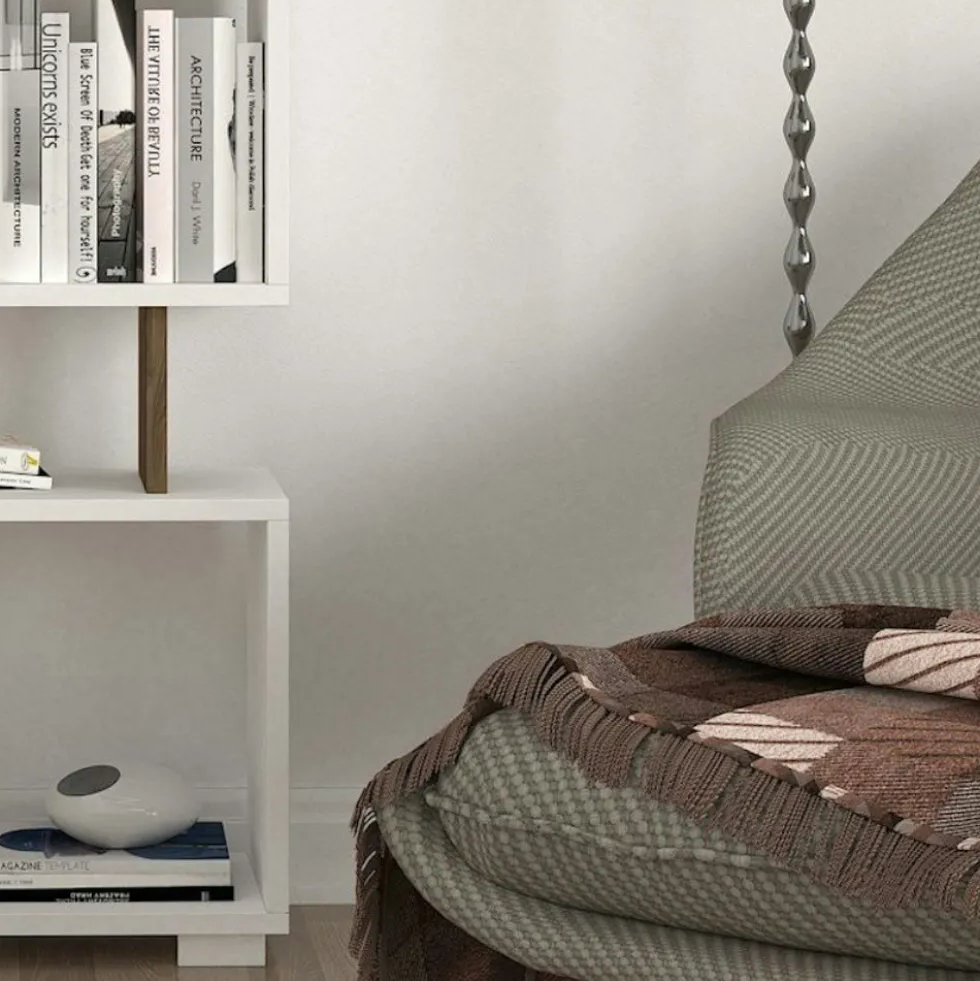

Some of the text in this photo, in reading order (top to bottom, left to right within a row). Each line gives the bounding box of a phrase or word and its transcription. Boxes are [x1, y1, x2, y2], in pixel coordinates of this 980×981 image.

[80, 48, 93, 70] Blue
[42, 23, 62, 150] Unicorns exists
[80, 74, 93, 107] Screen
[80, 110, 93, 121] Of
[190, 54, 202, 162] ARCHITECTURE
[80, 125, 93, 152] Death
[80, 154, 93, 170] Get
[13, 108, 21, 248] MODERN ARCHITECTURE
[80, 174, 91, 191] one
[80, 194, 93, 212] for
[111, 169, 122, 238] Photography
